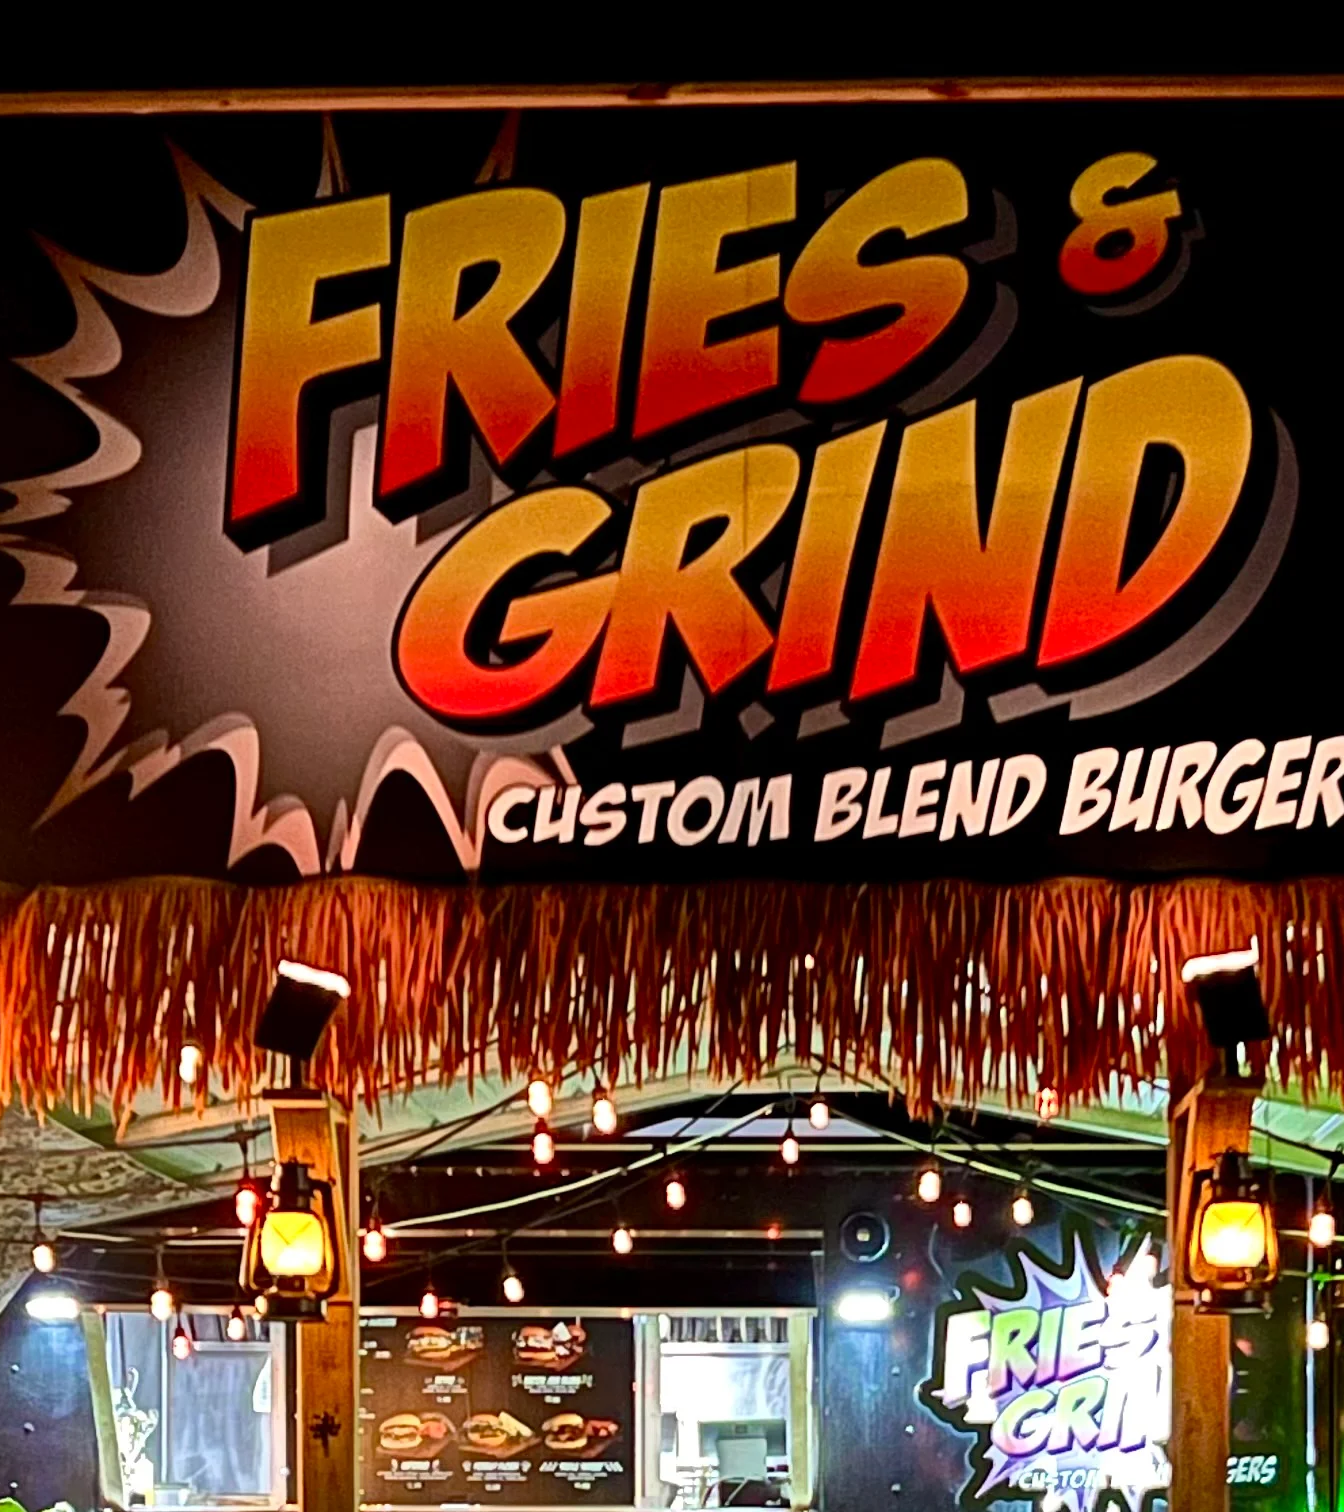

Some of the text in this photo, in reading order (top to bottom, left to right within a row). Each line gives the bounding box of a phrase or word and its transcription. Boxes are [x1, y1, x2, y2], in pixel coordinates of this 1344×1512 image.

[226, 151, 1182, 522] FRIES &
[394, 354, 1253, 718] GRIND
[487, 774, 793, 847] CUSTOM
[813, 753, 1048, 842] BLEND
[942, 1298, 1160, 1404] FRIES
